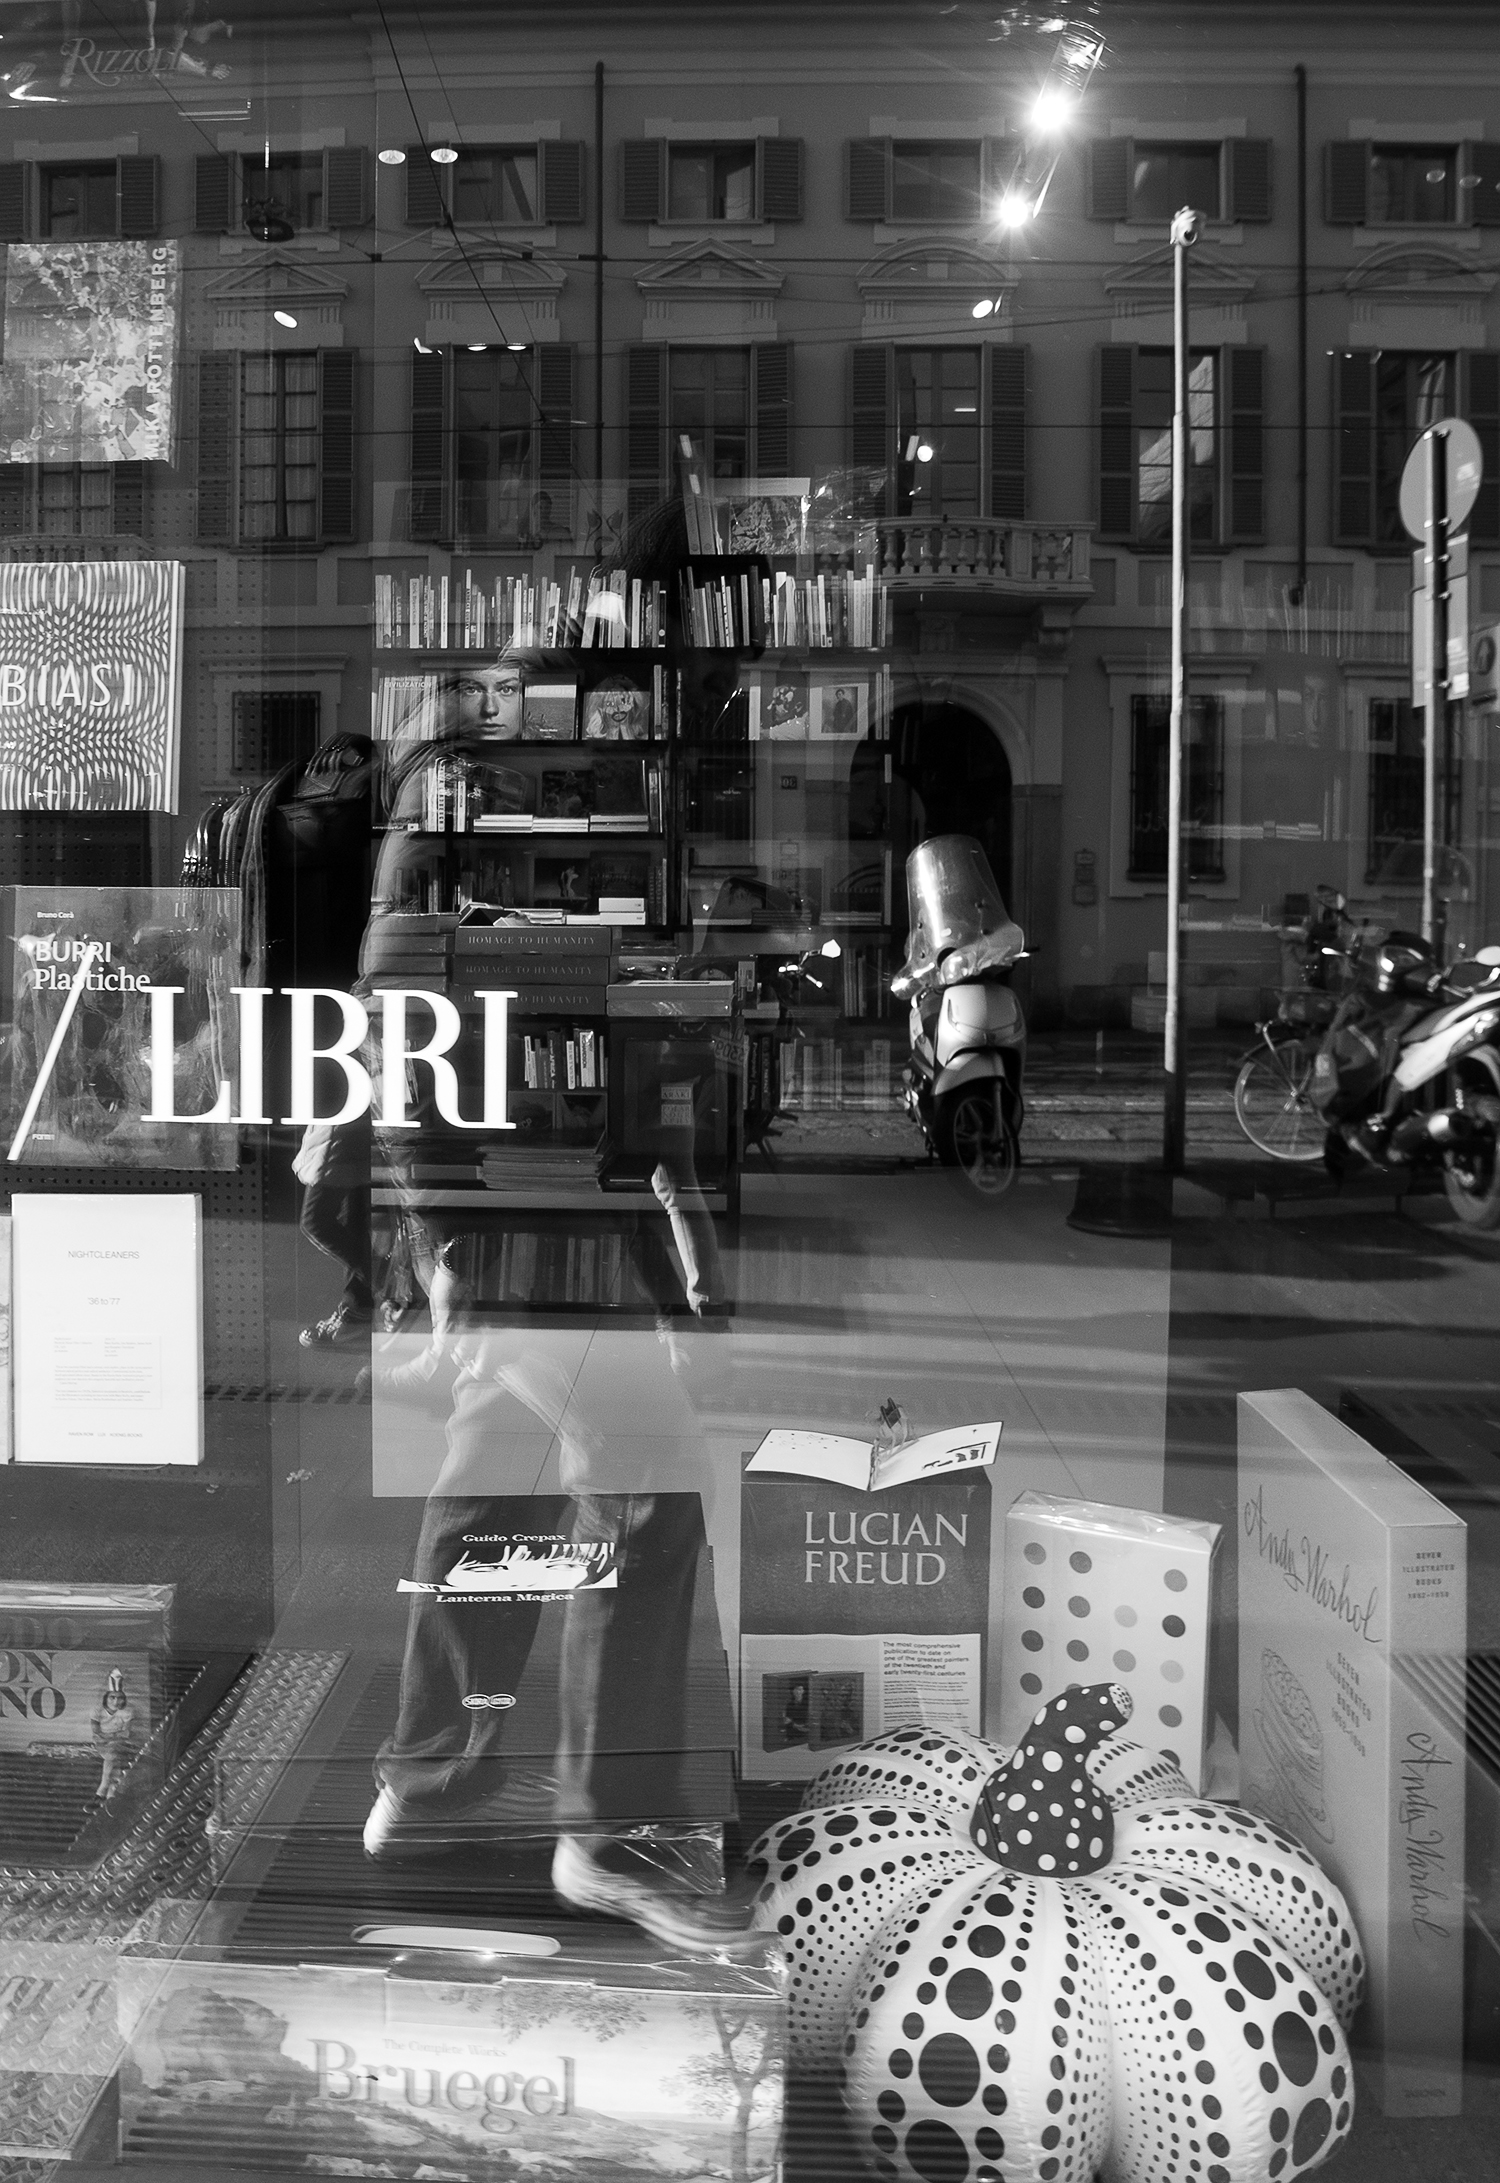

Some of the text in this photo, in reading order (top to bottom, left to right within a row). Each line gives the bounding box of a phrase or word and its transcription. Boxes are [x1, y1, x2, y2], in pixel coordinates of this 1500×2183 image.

[144, 245, 168, 460] MIKA ROTTENBERG
[2, 660, 132, 706] BIASI
[36, 941, 111, 963] BURRI
[468, 936, 595, 945] HOMAGE TO HUMANITY
[466, 965, 592, 975] HOMAGE TO HUMANITY
[141, 987, 518, 1129] LIBRI
[68, 1250, 140, 1259] NIGHTCLEANERS
[461, 1533, 566, 1543] Guido Crepax
[804, 1511, 968, 1547] LUCIAN
[804, 1551, 946, 1586] FREUD
[1243, 1484, 1383, 1643] Andy Warhol
[435, 1592, 575, 1603] Lanterna Magica
[1400, 1732, 1452, 1941] Andy Warhol
[382, 2038, 508, 2057] The Complete Works
[307, 2037, 577, 2135] Bruegel
